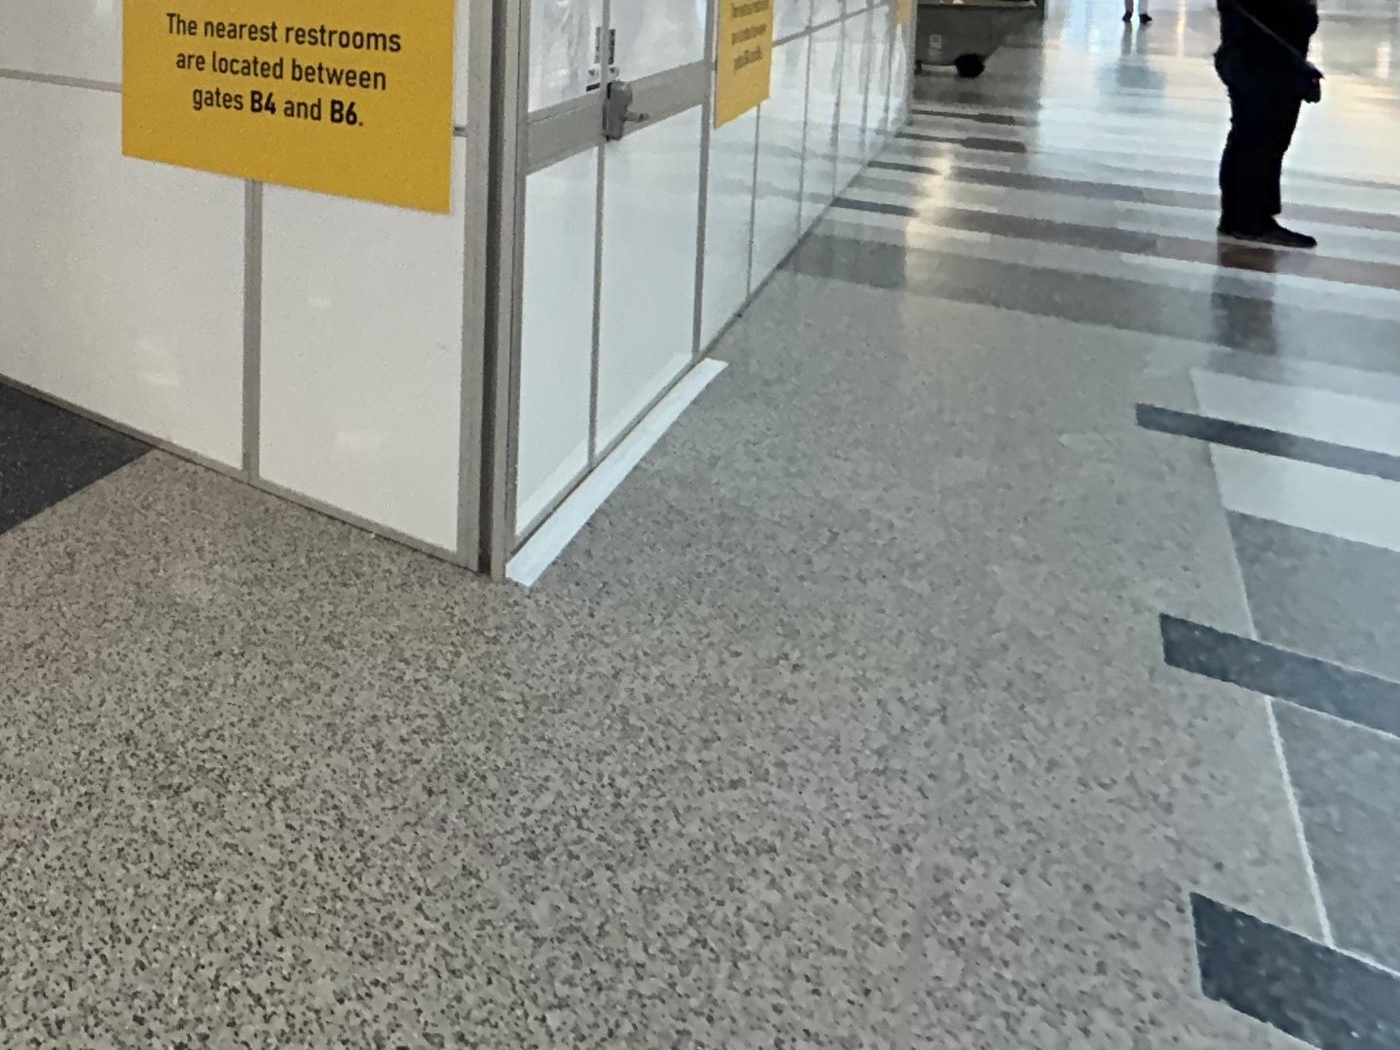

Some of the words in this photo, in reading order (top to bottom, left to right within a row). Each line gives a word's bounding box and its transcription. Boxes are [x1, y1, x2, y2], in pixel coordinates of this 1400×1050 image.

[166, 12, 198, 36] The
[203, 20, 278, 43] nearest
[284, 24, 402, 53] restrooms
[175, 52, 206, 71] are
[211, 50, 284, 80] located
[291, 58, 386, 91] between
[192, 86, 244, 111] gates
[250, 90, 277, 115] B4
[284, 98, 322, 121] and
[330, 99, 364, 127] B6.
